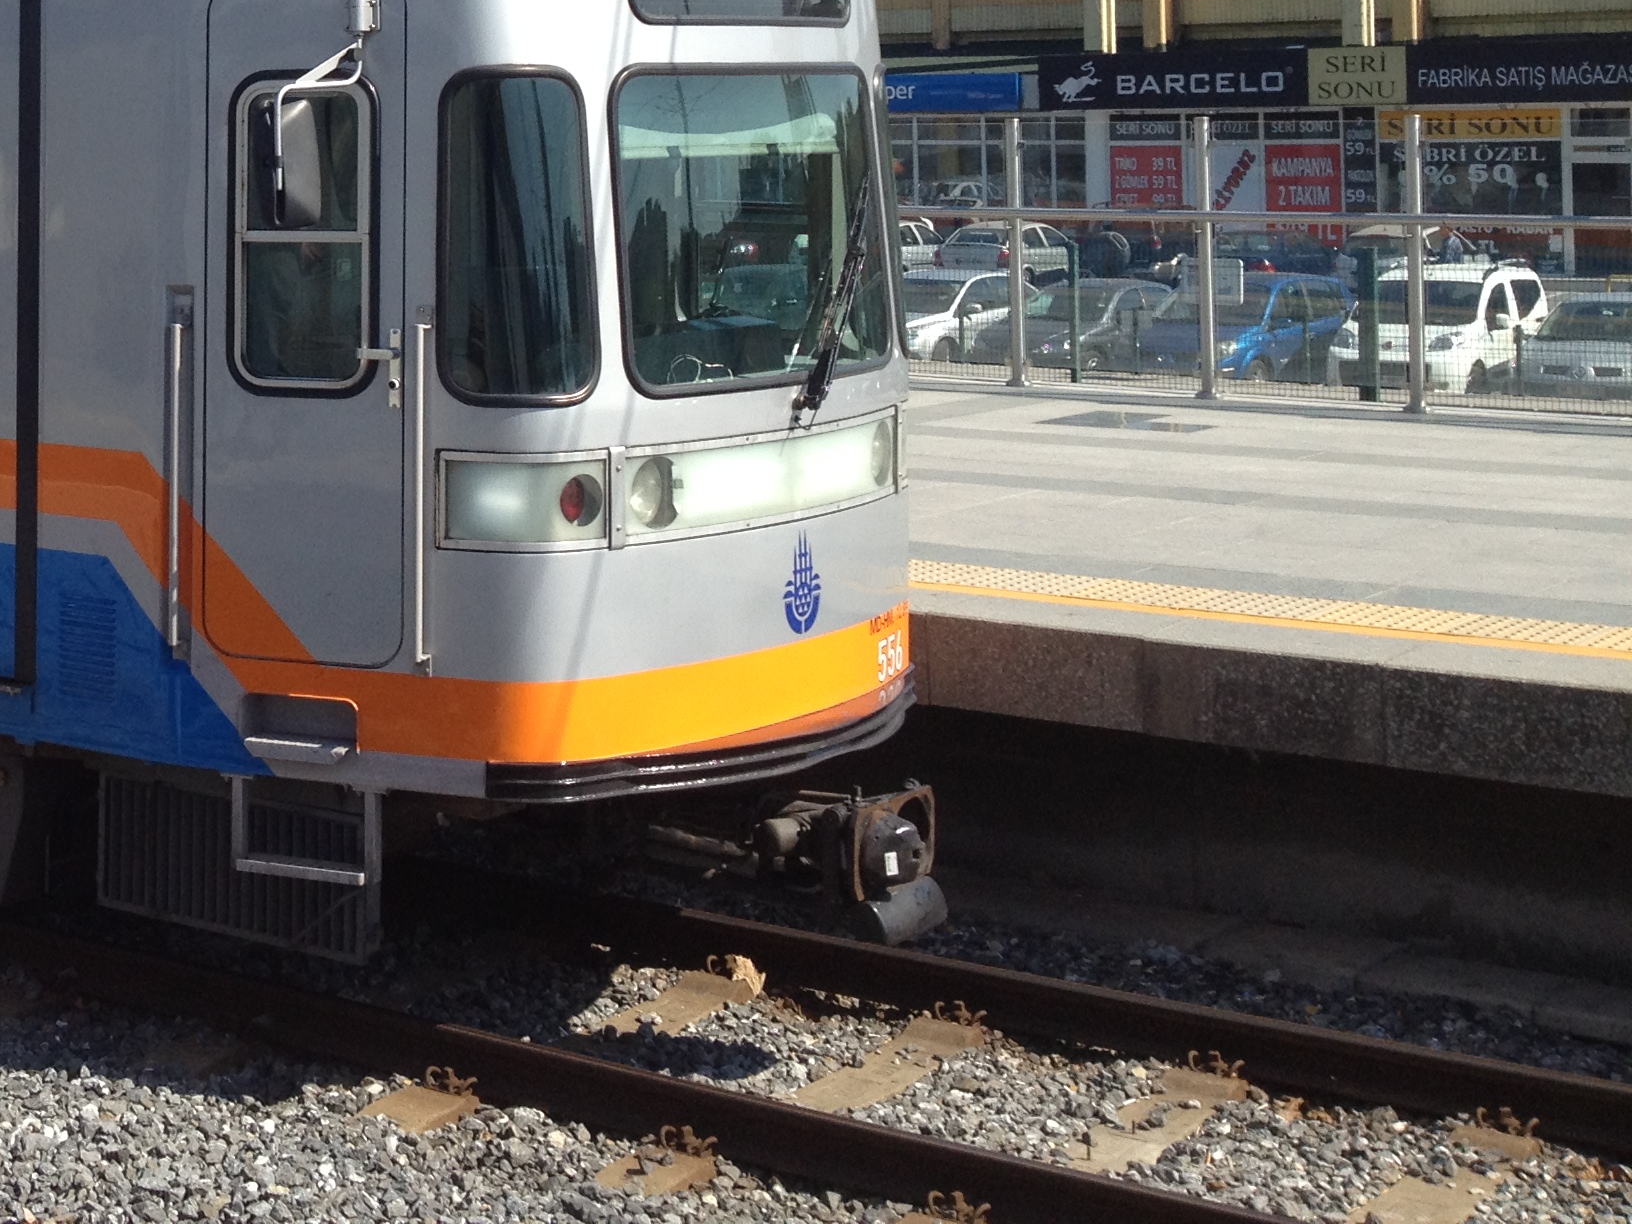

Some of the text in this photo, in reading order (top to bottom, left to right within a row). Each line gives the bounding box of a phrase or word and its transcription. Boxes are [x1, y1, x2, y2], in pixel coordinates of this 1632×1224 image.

[1325, 52, 1387, 74] SERİ
[1117, 71, 1284, 95] BARCELO
[1418, 65, 1492, 88] FABRİKA
[1495, 66, 1546, 91] SATIŞ
[1318, 80, 1396, 100] SONU
[1388, 113, 1457, 136] SRİ
[1468, 116, 1555, 136] SONU
[1345, 141, 1365, 155] 59
[1393, 143, 1546, 163] SBRİ ÖZEL
[1272, 157, 1334, 177] KAMPANYA
[1469, 163, 1515, 184] 50
[1278, 186, 1331, 206] 2 TAKIM
[1346, 188, 1366, 204] 59
[878, 629, 904, 683] 556
